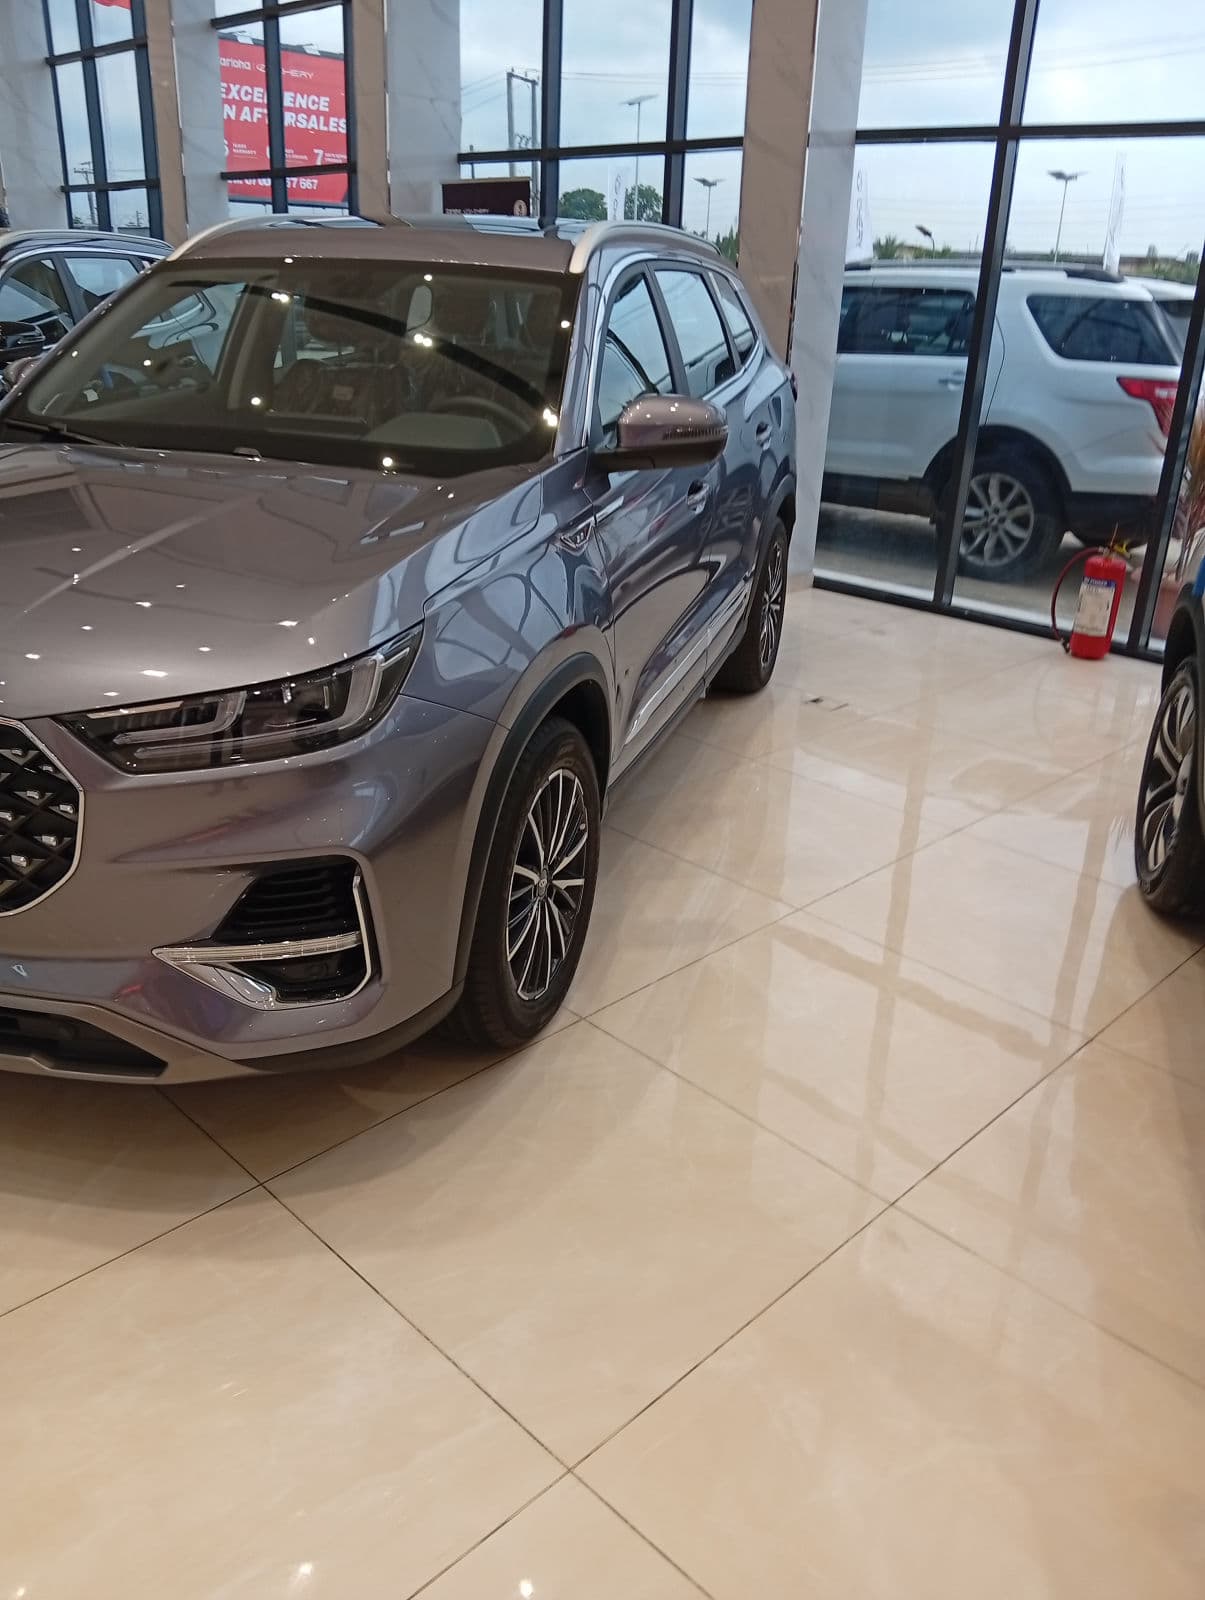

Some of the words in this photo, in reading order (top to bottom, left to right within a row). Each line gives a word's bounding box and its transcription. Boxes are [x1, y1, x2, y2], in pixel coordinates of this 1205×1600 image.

[281, 68, 314, 80] HERY
[220, 82, 330, 112] EXCEENCE
[223, 104, 237, 121] N
[240, 106, 347, 134] AFRSALES
